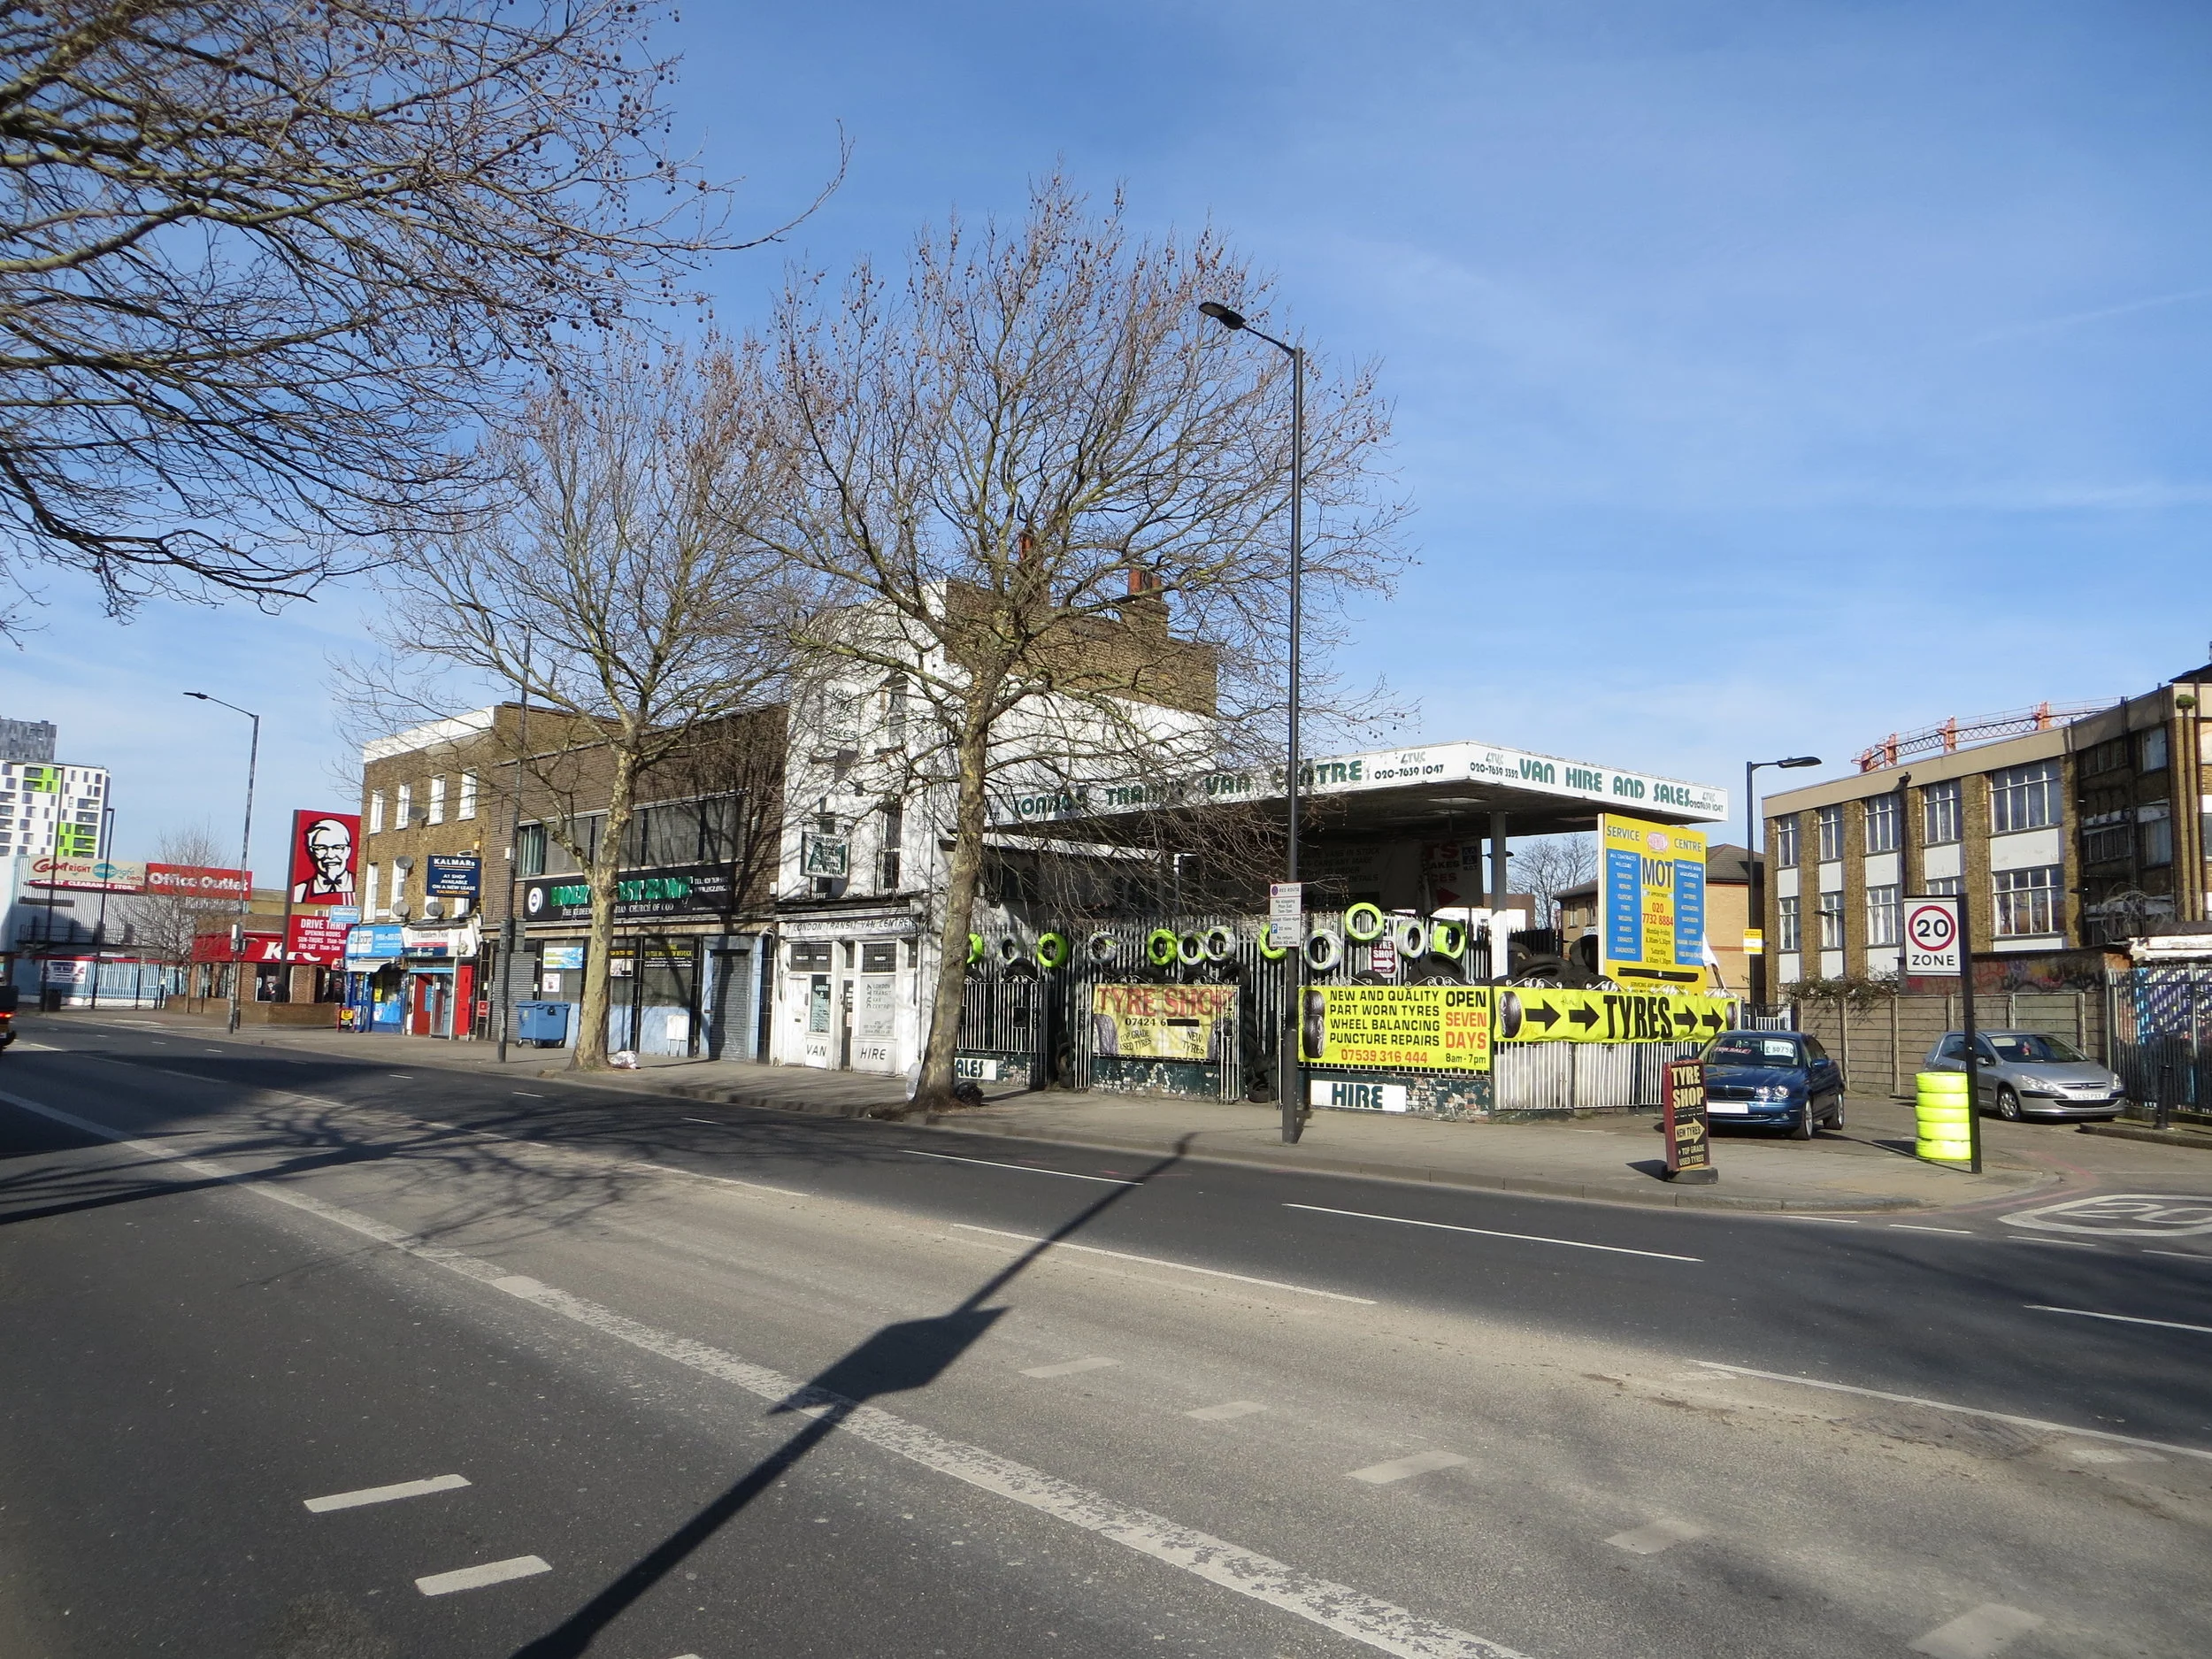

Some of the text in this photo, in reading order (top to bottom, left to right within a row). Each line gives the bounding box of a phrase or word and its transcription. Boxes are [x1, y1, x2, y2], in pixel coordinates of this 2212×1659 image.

[1205, 772, 1252, 795] VAN
[1270, 760, 1363, 790] CNTRE
[1374, 764, 1444, 779] 020-7639 1047
[1519, 758, 1690, 807] VAN HIRE AND SALES
[1606, 826, 1640, 841] SERVICE
[1674, 838, 1701, 852] CENTRE
[1642, 857, 1672, 887] MOT
[149, 872, 197, 887] Office
[629, 903, 650, 912] CHURCH
[1652, 902, 1663, 913] 020
[301, 918, 324, 929] DRIVE
[793, 922, 822, 931] LONDON
[826, 920, 856, 930] TRANSIT
[879, 918, 910, 928] CENTRE
[1642, 913, 1656, 925] 7732
[1916, 919, 1948, 938] 20
[1373, 949, 1394, 958] SHOP
[1651, 948, 1666, 956] Saturday
[1912, 955, 1955, 966] ZONE
[1097, 987, 1236, 1018] TYRE SHOP
[1330, 990, 1439, 1002] NEW AND QUALITY
[1446, 991, 1486, 1007] OPEN
[1330, 1005, 1440, 1017] PART WORN TYRES
[1603, 995, 1673, 1039] TYRES
[1125, 1018, 1156, 1026] 07424
[1331, 1018, 1440, 1032] WHEEL BALANCING
[1446, 1012, 1486, 1027] SEVEN
[1131, 1029, 1149, 1038] GRADE
[1187, 1032, 1203, 1044] NEW
[1330, 1033, 1440, 1047] PUNCTURE REPAIRS
[1446, 1031, 1486, 1049] DAYS
[806, 1044, 827, 1056] VAN
[1119, 1038, 1152, 1051] USED TYRES
[1182, 1040, 1204, 1055] TYRES
[860, 1048, 887, 1060] HIRE
[1341, 1048, 1428, 1064] 07539 316 444
[956, 1059, 984, 1078] ALES
[1671, 1065, 1701, 1087] TYRE
[1332, 1083, 1383, 1109] HIRE
[1672, 1087, 1704, 1110] SHOP
[1677, 1125, 1701, 1137] NEW TYRES
[1691, 1144, 1705, 1154] GRADE
[1678, 1155, 1704, 1166] USED TYRES
